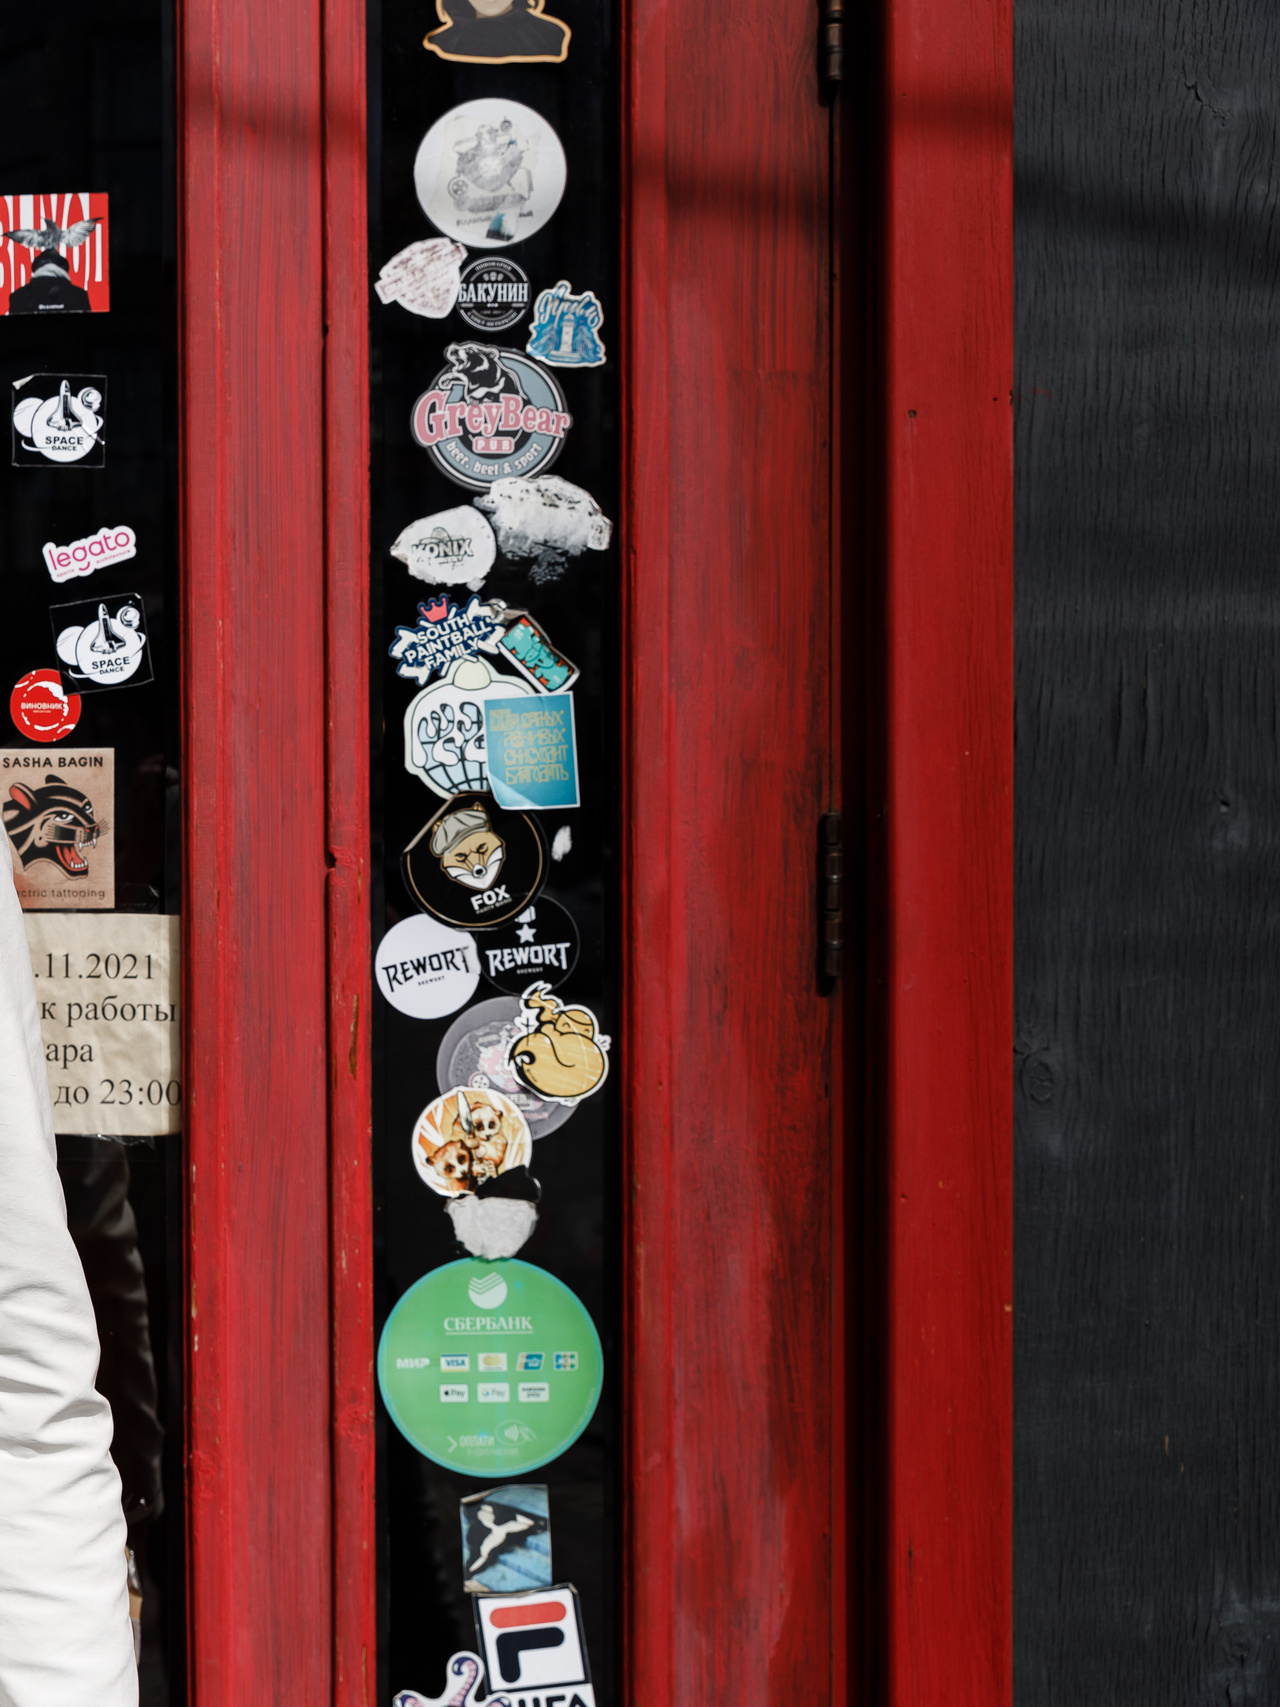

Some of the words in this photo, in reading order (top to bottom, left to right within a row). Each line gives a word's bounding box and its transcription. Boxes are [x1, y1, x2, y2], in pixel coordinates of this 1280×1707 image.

[459, 282, 528, 303] БАКУНИН
[414, 389, 570, 446] GreyBear
[45, 436, 84, 445] SPACE
[477, 439, 510, 451] PUB
[474, 461, 499, 476] beef
[503, 463, 512, 474] &
[514, 442, 543, 470] sport
[48, 532, 130, 571] legato
[416, 613, 470, 644] SOUTH
[405, 620, 492, 663] PAINTBALL
[424, 637, 480, 669] FAMILY
[91, 656, 131, 670] SPACE
[99, 667, 125, 675] DANCE
[2, 757, 53, 768] SASHA
[58, 757, 104, 768] BAGIN
[51, 888, 105, 900] tattooing
[470, 884, 511, 911] FOX
[381, 946, 470, 993] REWORT
[485, 942, 571, 977] REWORT
[66, 994, 177, 1028] работы
[53, 1085, 89, 1107] до
[99, 1078, 183, 1106] 23:00
[443, 1316, 534, 1332] СБЕРБАНК
[396, 1357, 431, 1369] МИР
[445, 1359, 466, 1367] VISA
